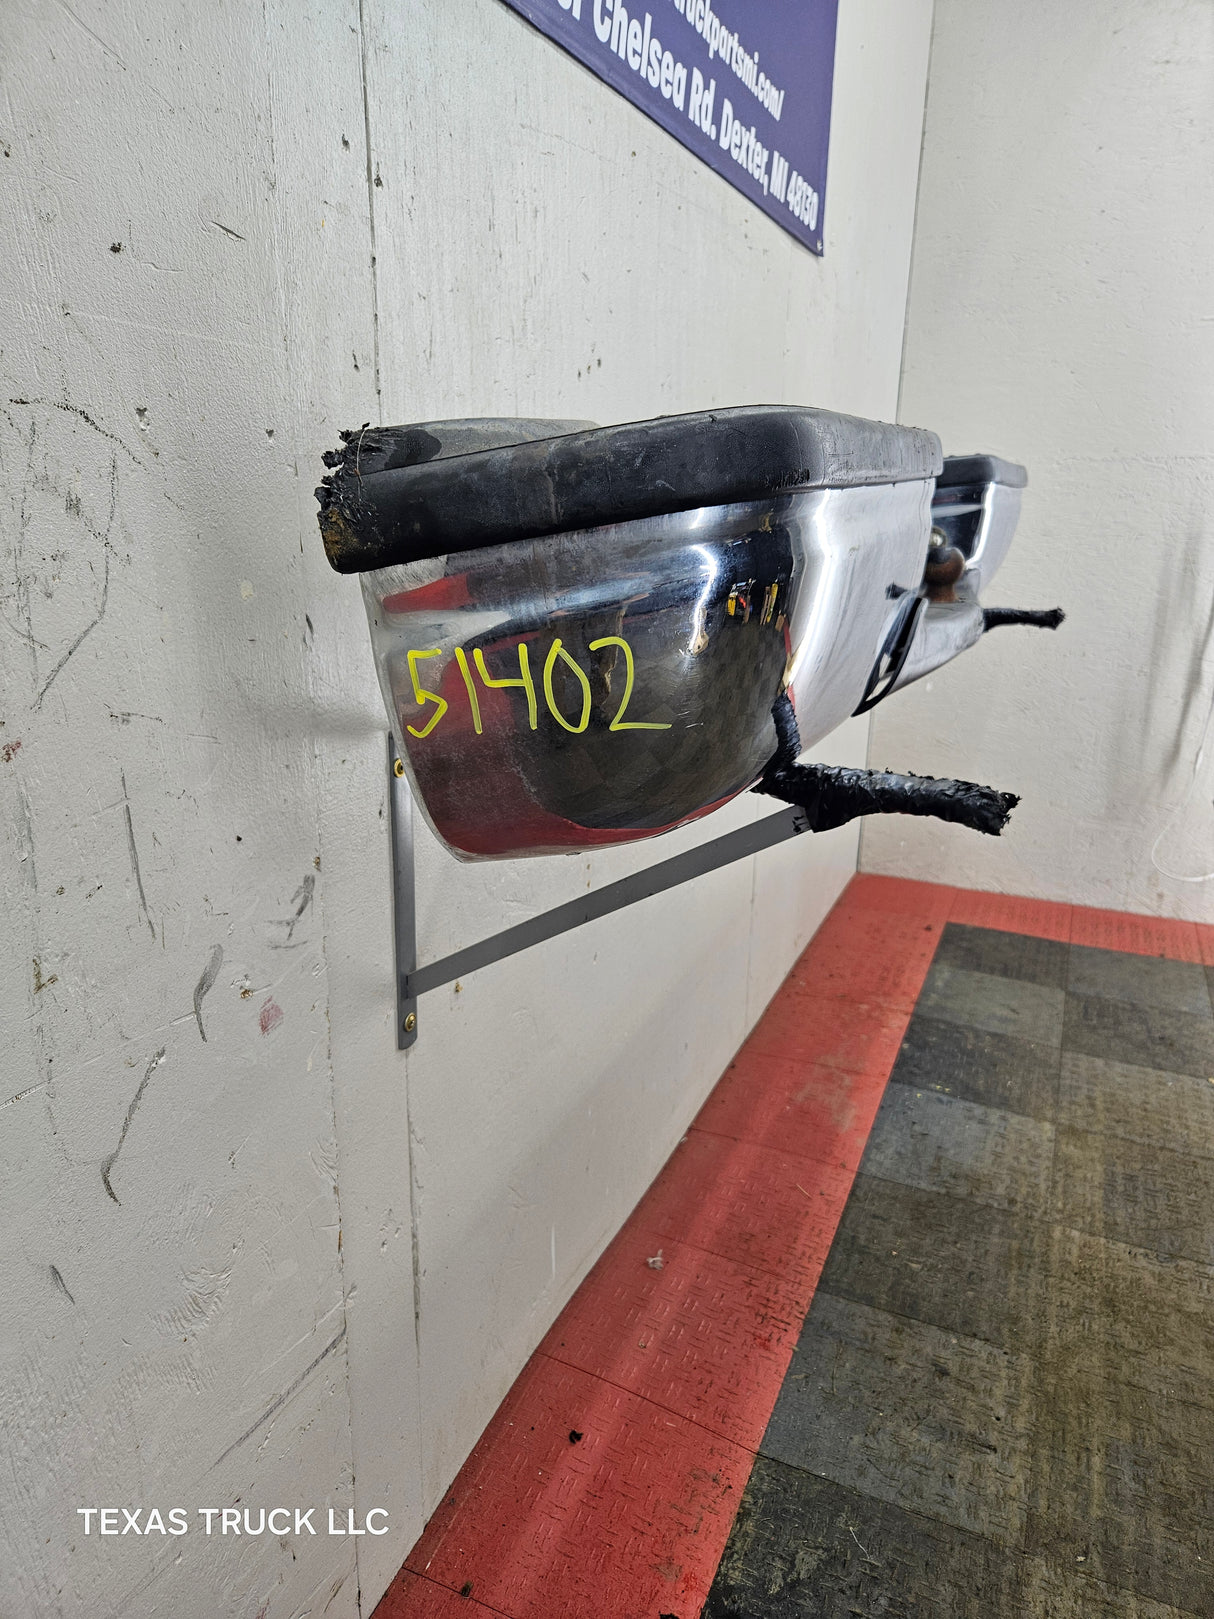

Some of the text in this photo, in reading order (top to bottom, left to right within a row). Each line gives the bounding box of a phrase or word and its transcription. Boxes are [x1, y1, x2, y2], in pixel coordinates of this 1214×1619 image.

[593, 0, 819, 231] Chelsea Rd. Dexter, MI 48130
[673, 0, 785, 121] uckpartsmi.com/
[406, 636, 673, 739] 51402
